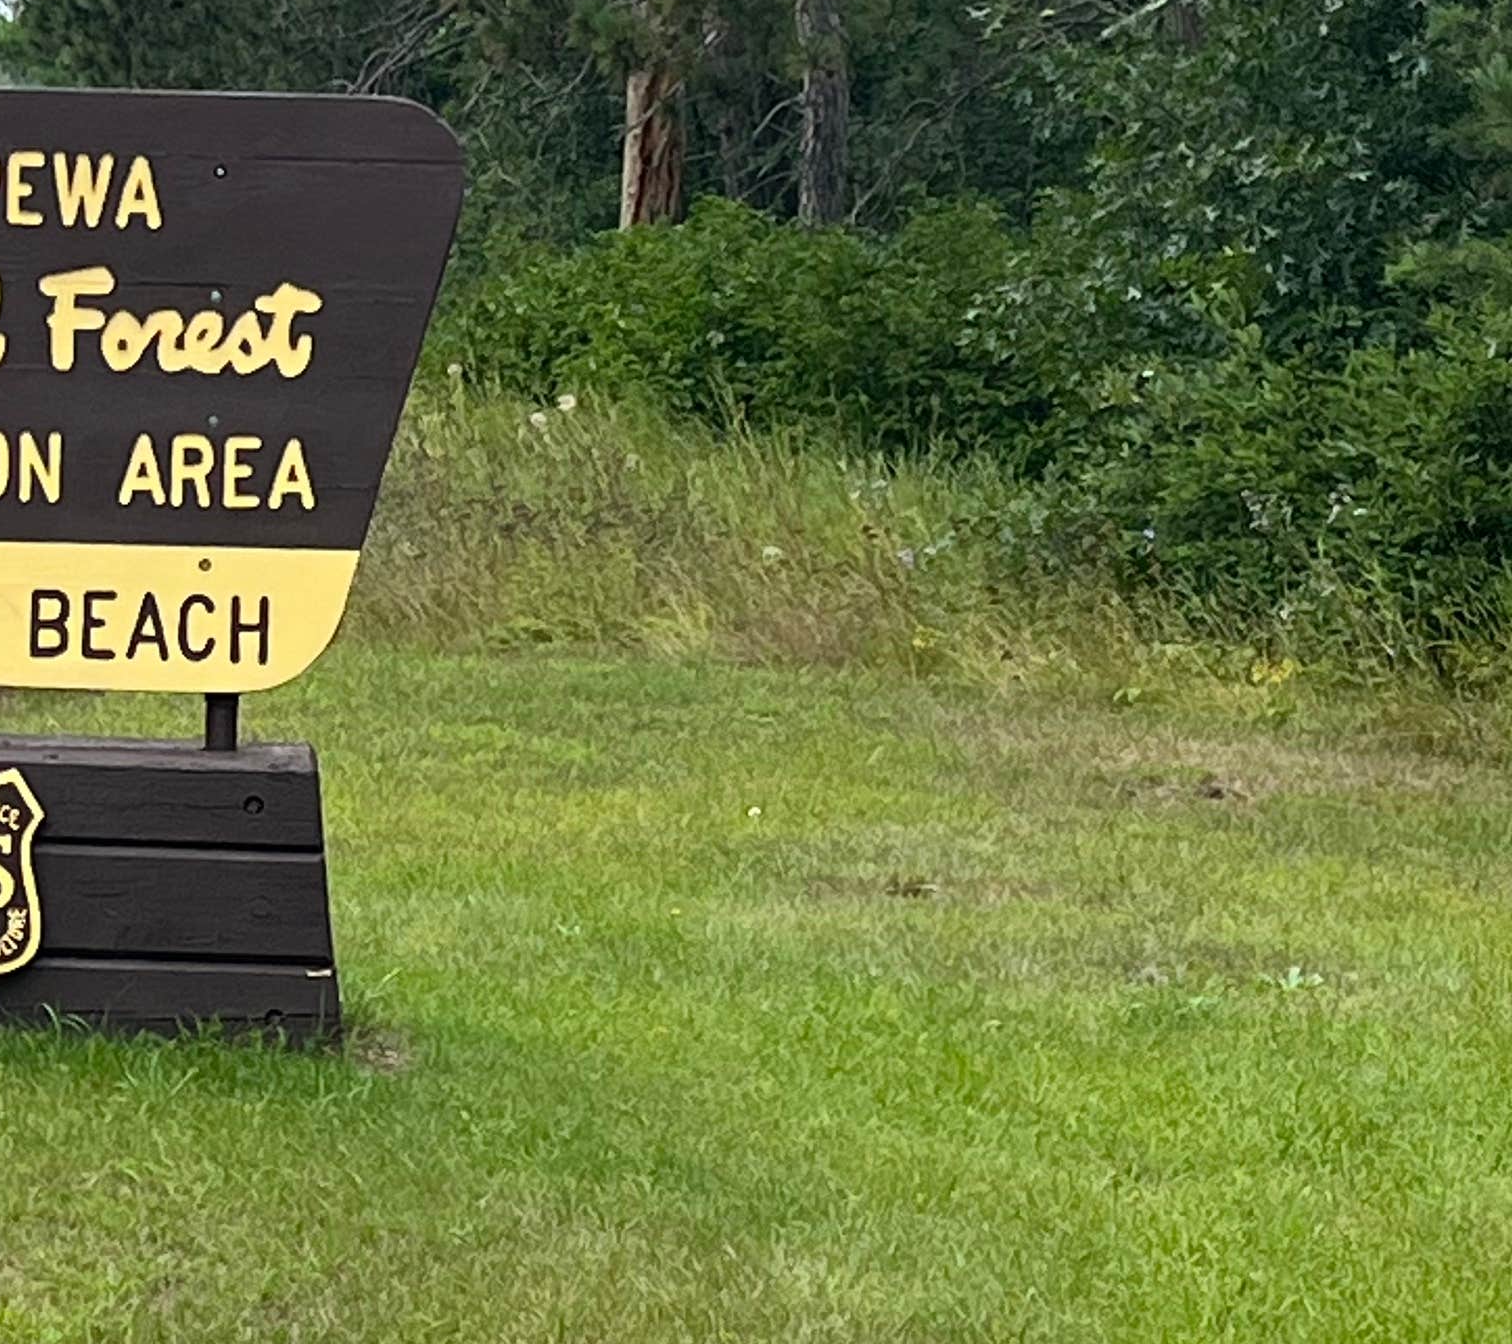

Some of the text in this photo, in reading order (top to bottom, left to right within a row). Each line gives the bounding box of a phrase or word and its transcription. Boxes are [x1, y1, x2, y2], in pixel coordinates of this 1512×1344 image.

[39, 266, 322, 378] Forest
[118, 433, 316, 510] AREA
[29, 588, 270, 666] BEACH
